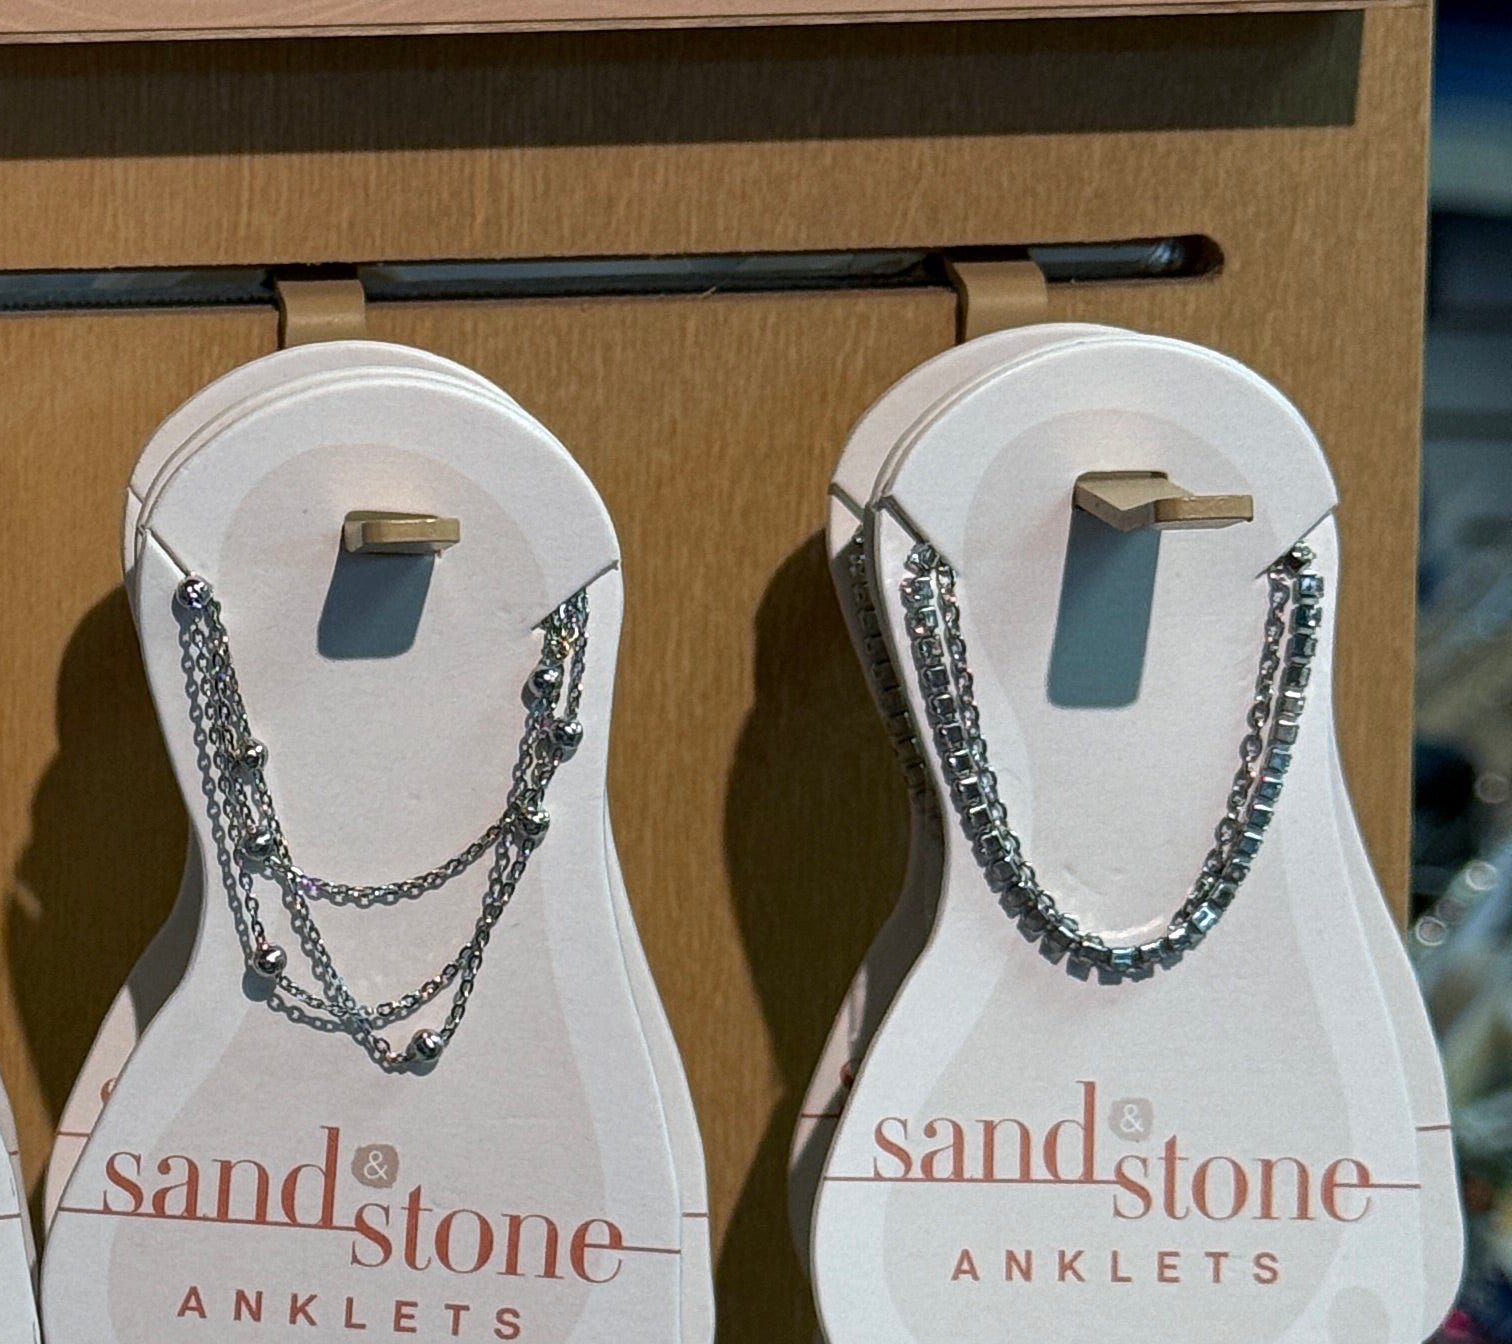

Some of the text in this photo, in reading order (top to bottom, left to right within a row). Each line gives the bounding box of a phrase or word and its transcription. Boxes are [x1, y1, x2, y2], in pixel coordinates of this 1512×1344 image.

[873, 1080, 1373, 1223] sand & stone
[102, 1125, 623, 1285] sand & stone
[176, 1285, 522, 1341] ANKLETS
[951, 1248, 1280, 1285] ANKLETS
